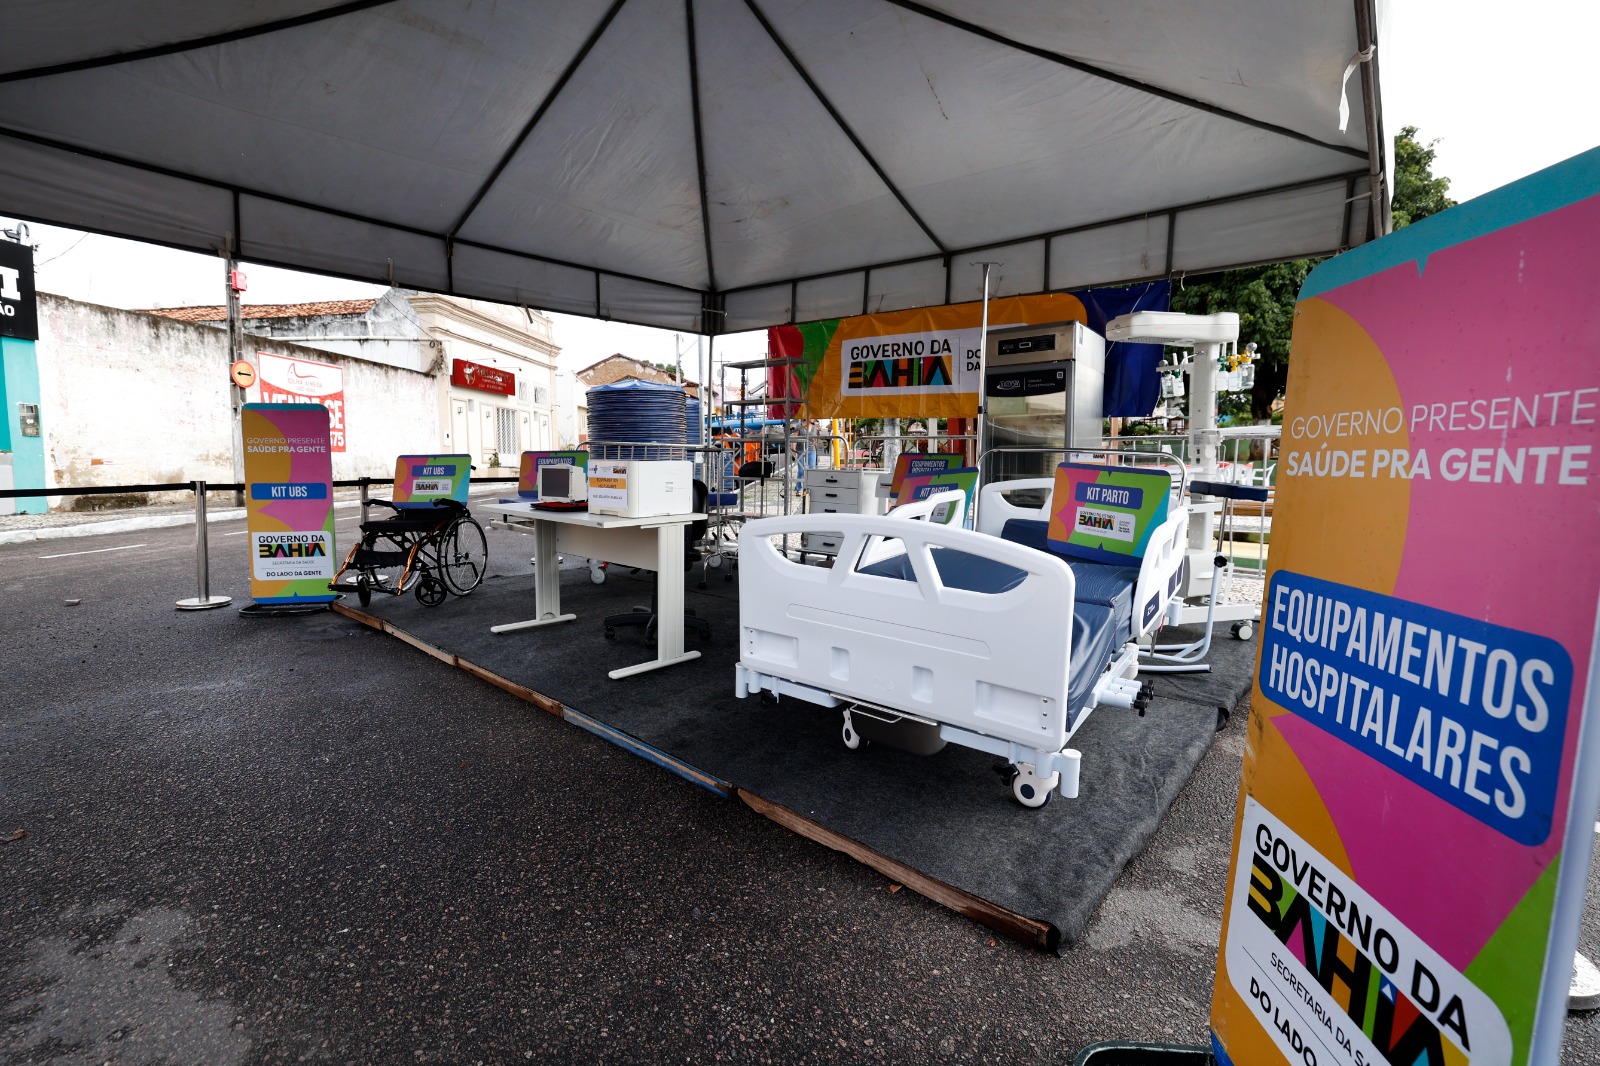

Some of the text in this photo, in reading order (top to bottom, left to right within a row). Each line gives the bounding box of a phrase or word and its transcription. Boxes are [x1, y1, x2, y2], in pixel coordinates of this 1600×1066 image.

[850, 338, 952, 360] GOVERNO DA
[848, 355, 953, 389] BAHIA
[966, 361, 981, 371] DA
[1291, 387, 1600, 439] GOVERNO PRESENTE
[247, 444, 277, 453] SAÚDE
[296, 445, 326, 453] GENTE
[422, 467, 433, 475] KIT
[537, 457, 573, 465] EQUIPAMENTOS
[1286, 442, 1592, 486] SAÚDE PRA GENTE
[271, 486, 308, 497] KIT UBS
[920, 488, 931, 497] KIT
[1086, 486, 1130, 505] KIT PARTO
[1078, 515, 1115, 530] BAHIA
[258, 534, 325, 543] GOVERNO DA
[258, 543, 326, 558] BAHIA
[1272, 584, 1555, 733] EQUIPAMENTOS
[1268, 643, 1531, 819] HOSPITALARES
[1255, 823, 1471, 1053] GOVERNO DA
[1247, 851, 1471, 1066] BAHIA
[1270, 952, 1333, 1034] SECRETARIA
[1335, 1026, 1352, 1057] DA
[1250, 976, 1317, 1066] DO LADO
